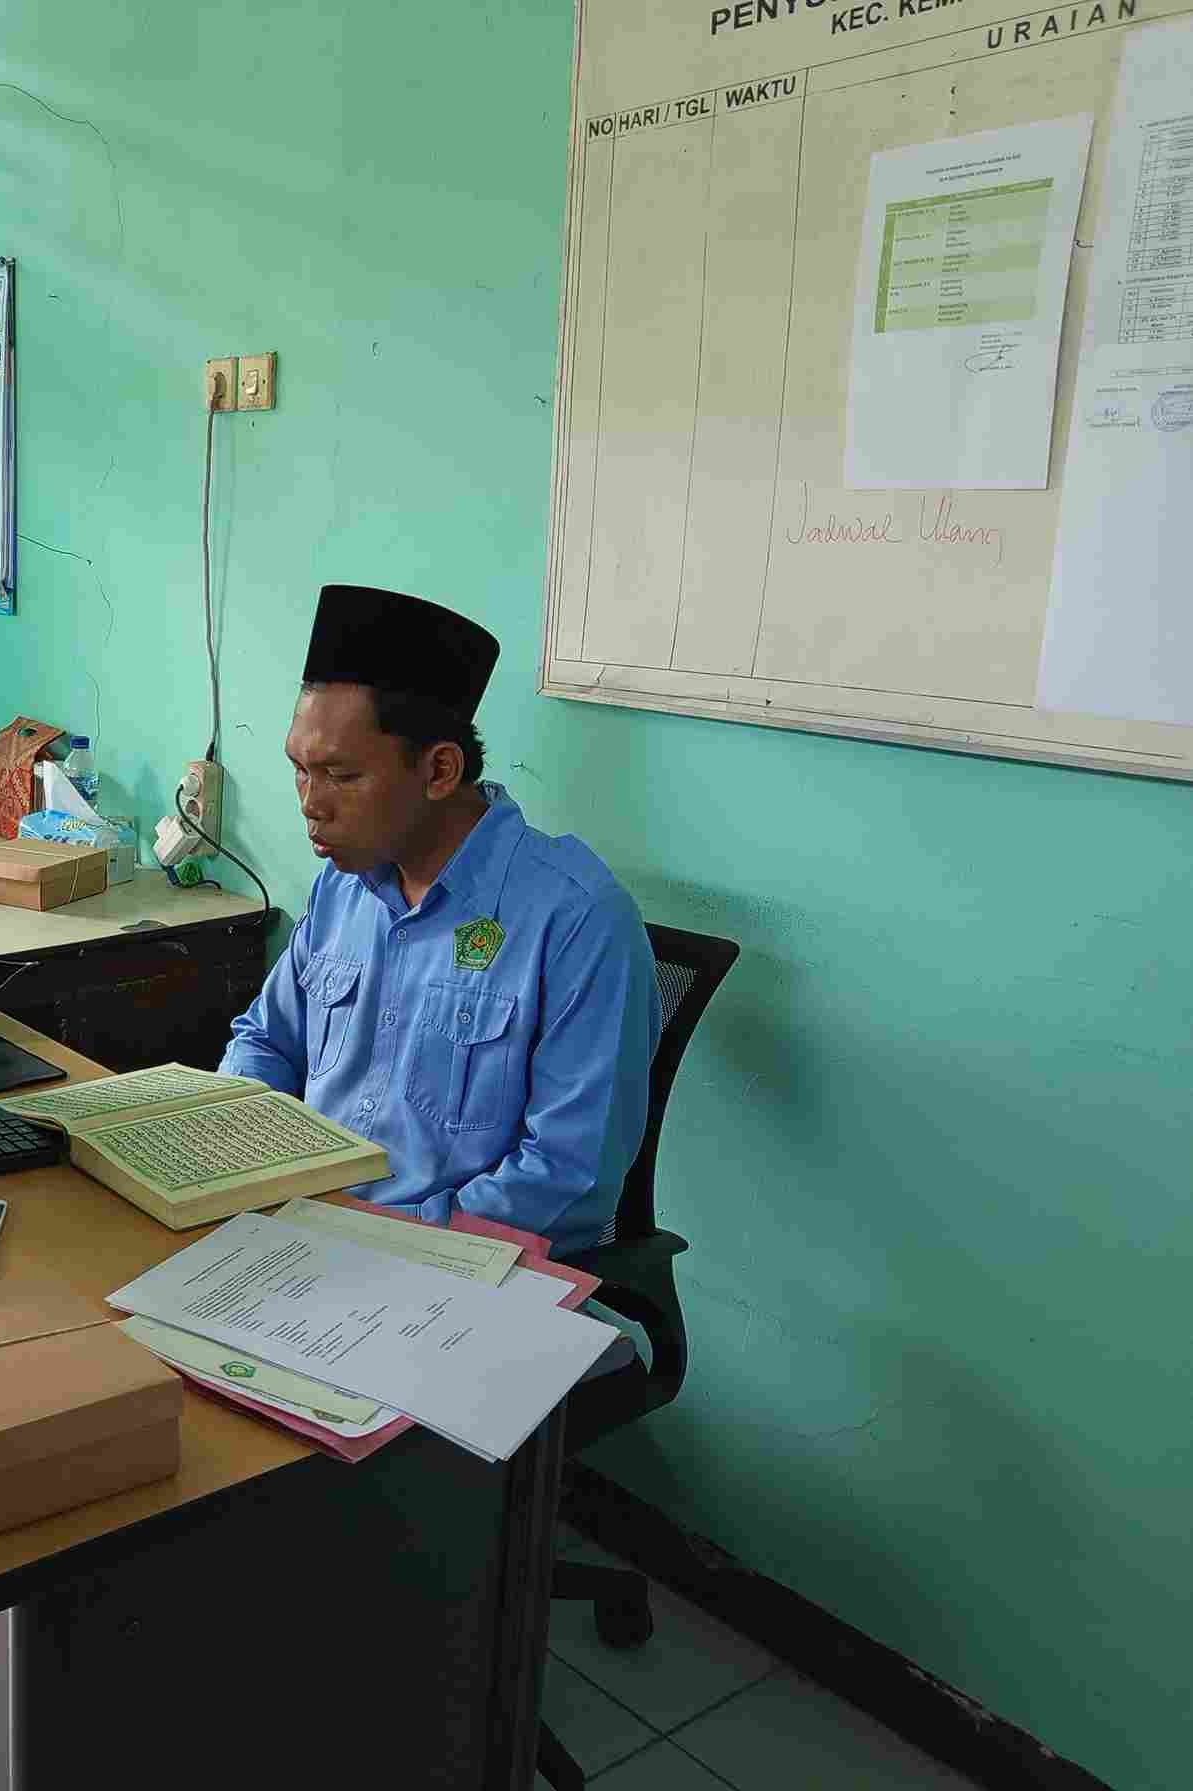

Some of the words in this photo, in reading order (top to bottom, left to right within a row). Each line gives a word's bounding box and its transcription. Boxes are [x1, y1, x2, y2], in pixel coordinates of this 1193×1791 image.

[711, 0, 839, 35] PENY
[831, 2, 889, 34] KEC.
[987, 0, 1137, 49] URAIAN
[725, 75, 797, 108] WAKTU
[588, 118, 614, 138] NO
[618, 106, 661, 132] HARI
[674, 97, 711, 120] TGL
